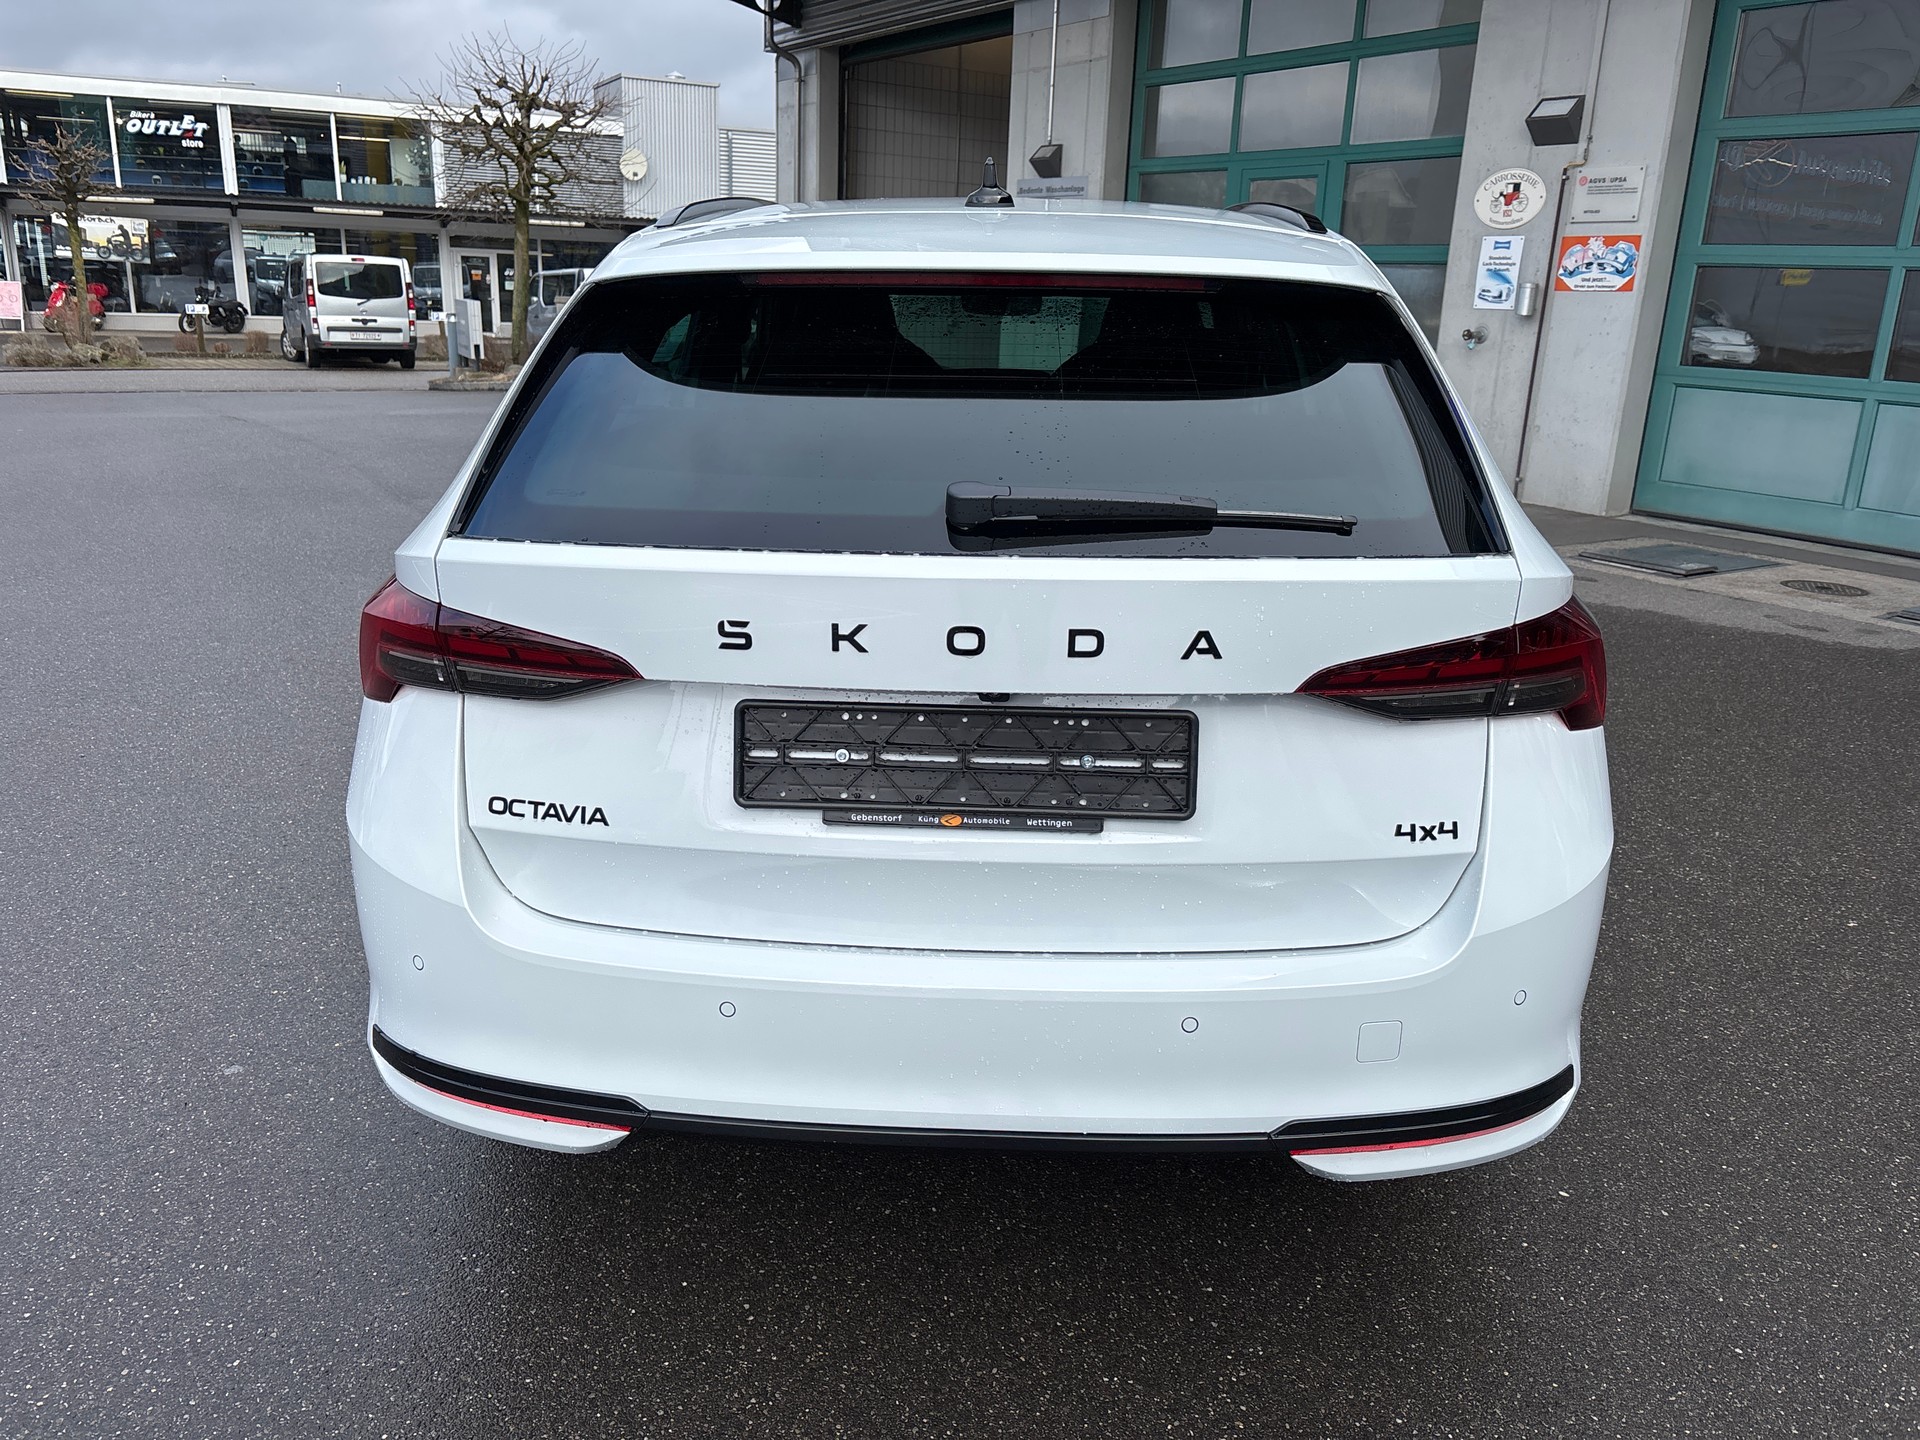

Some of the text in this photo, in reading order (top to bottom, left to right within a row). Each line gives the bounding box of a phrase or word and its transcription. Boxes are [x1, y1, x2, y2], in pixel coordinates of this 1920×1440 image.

[126, 115, 208, 138] OUTLET
[181, 139, 204, 148] store
[1483, 172, 1540, 191] CARROSSERIE
[488, 796, 610, 826] OCTAVIA
[851, 813, 1073, 829] Gebenstorf Küng Automobile Wettingen
[1394, 821, 1459, 842] 4x4
